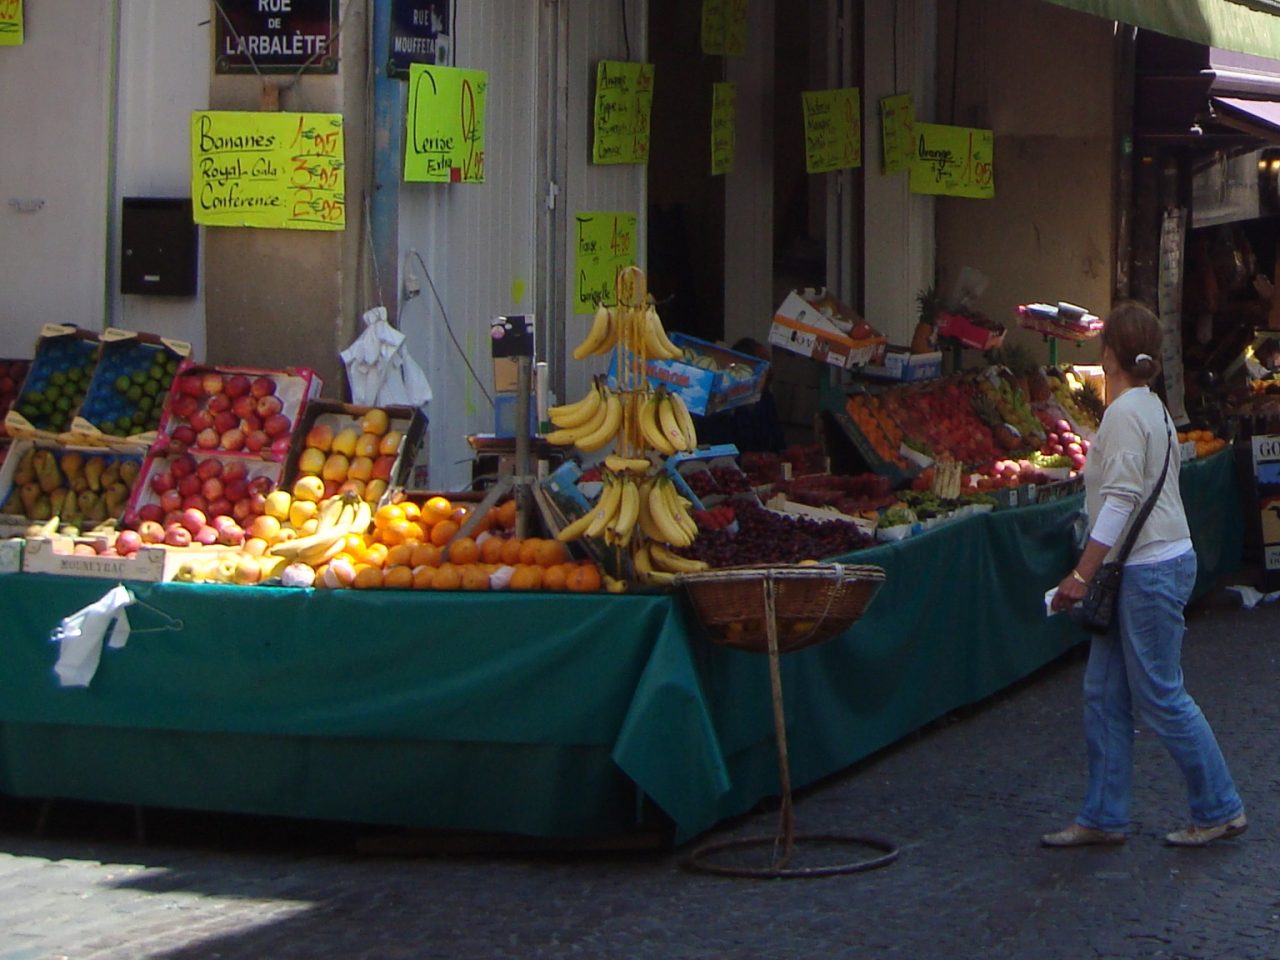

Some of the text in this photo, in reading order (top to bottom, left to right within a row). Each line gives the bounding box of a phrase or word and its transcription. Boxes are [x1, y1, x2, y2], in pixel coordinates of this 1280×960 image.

[267, 18, 281, 29] DE
[413, 8, 430, 26] RUE
[394, 36, 436, 55] MOUFFETA
[413, 70, 455, 154] Cerise
[919, 133, 953, 169] Orange
